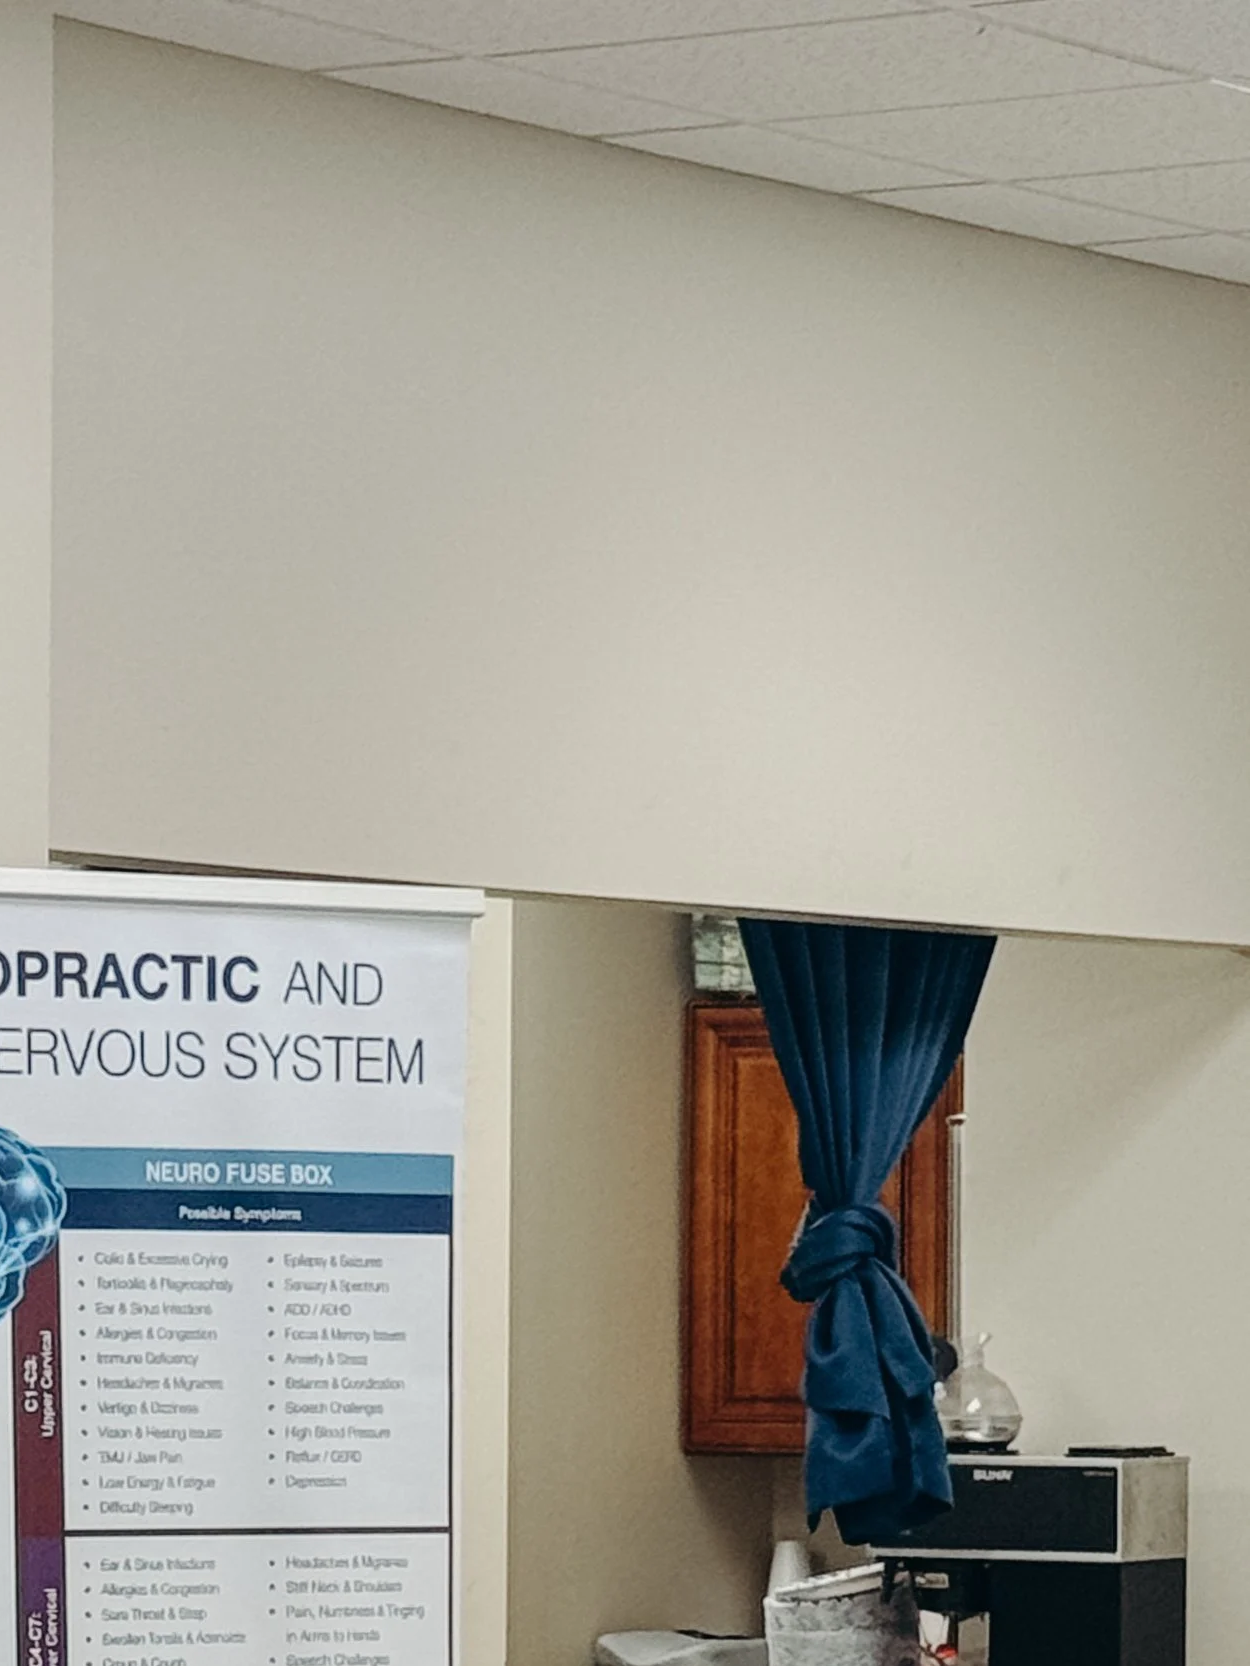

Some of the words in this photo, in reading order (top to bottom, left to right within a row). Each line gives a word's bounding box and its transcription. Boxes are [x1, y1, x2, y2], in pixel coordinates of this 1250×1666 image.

[283, 961, 384, 1006] AND
[224, 1031, 426, 1085] SYSTEM
[146, 1161, 220, 1184] NEURO
[226, 1162, 286, 1185] FUSE
[291, 1164, 334, 1186] BOX
[179, 1206, 231, 1221] Possible
[233, 1206, 302, 1224] Symptoms
[39, 1330, 53, 1390] Cervical
[40, 1392, 56, 1438] Upper
[43, 1588, 58, 1647] Cervical
